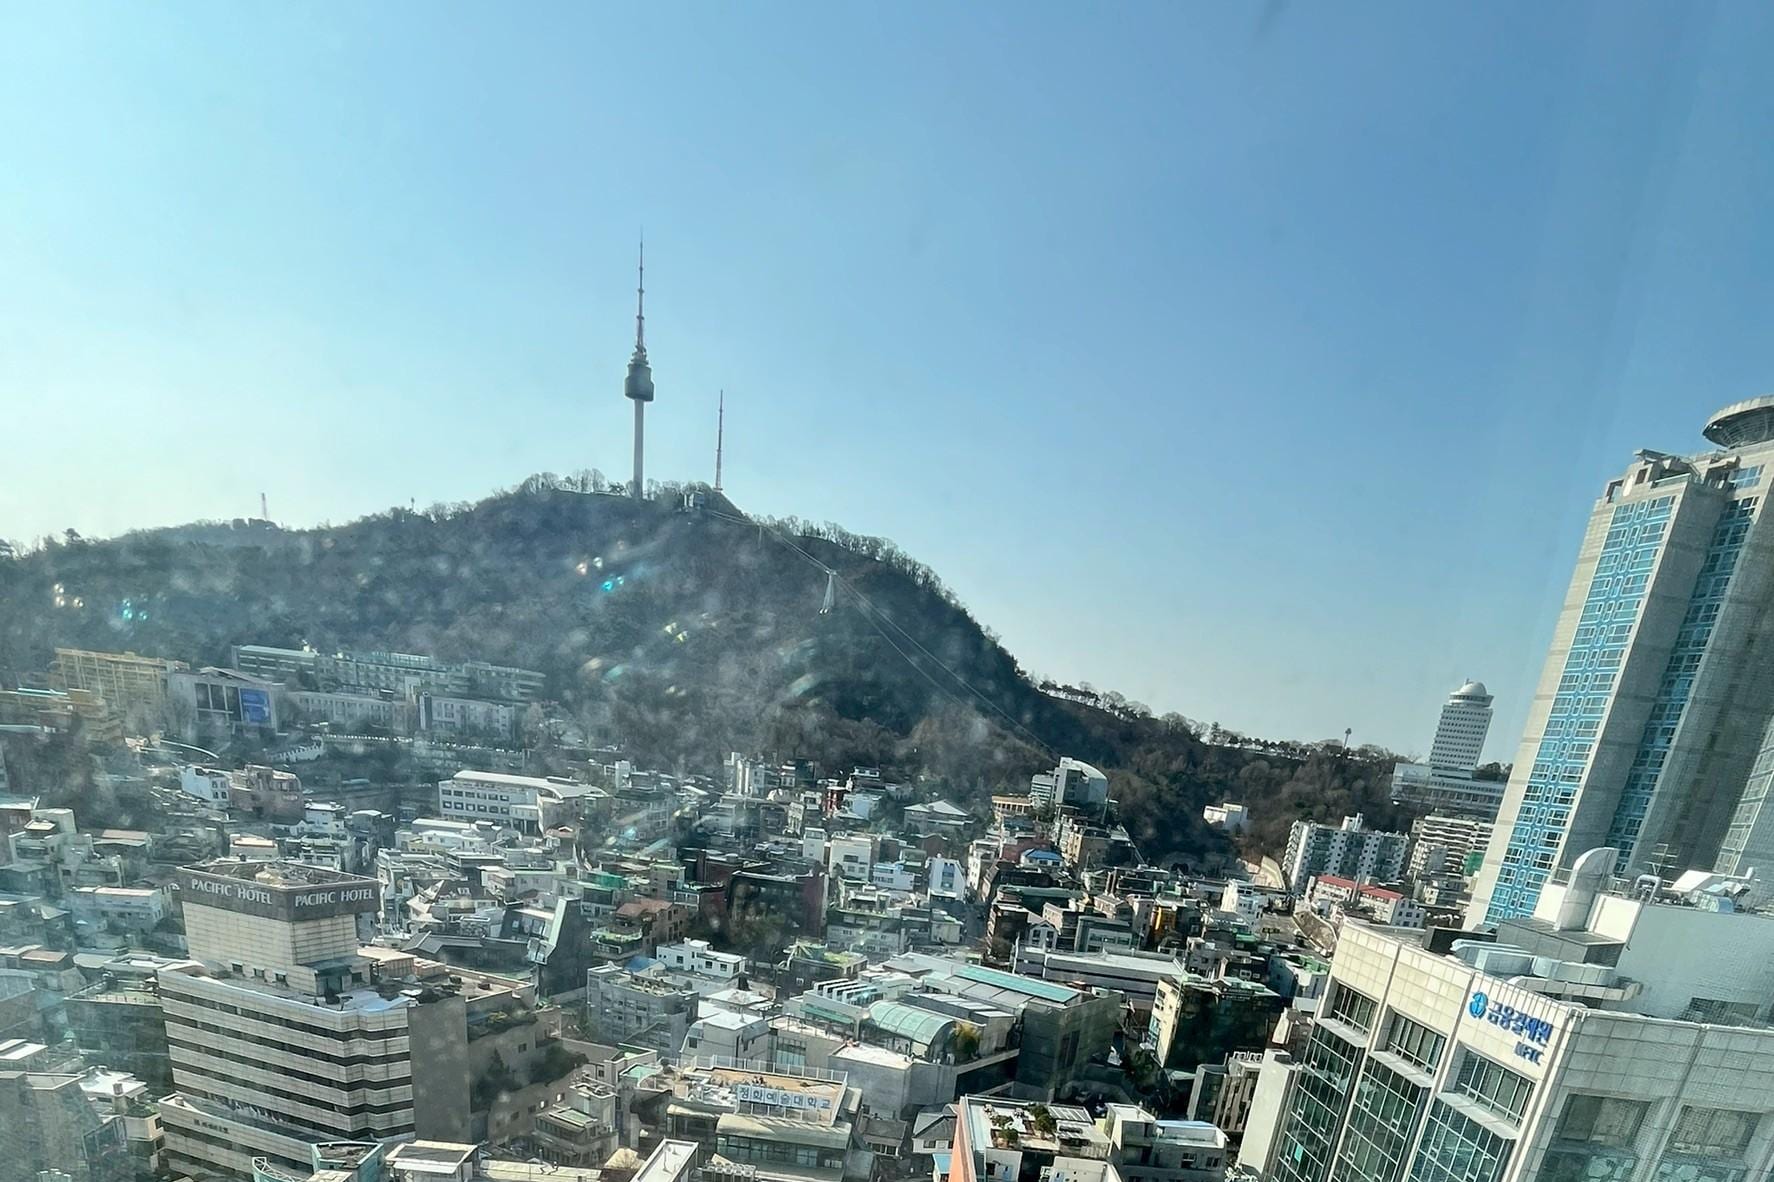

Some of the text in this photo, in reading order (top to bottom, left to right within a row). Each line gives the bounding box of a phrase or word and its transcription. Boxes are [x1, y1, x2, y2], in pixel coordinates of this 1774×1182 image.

[191, 878, 273, 905] PACIFIC HOTEL
[295, 888, 375, 907] PACIFIC HOTEL
[1486, 1000, 1554, 1048] 금융결제원
